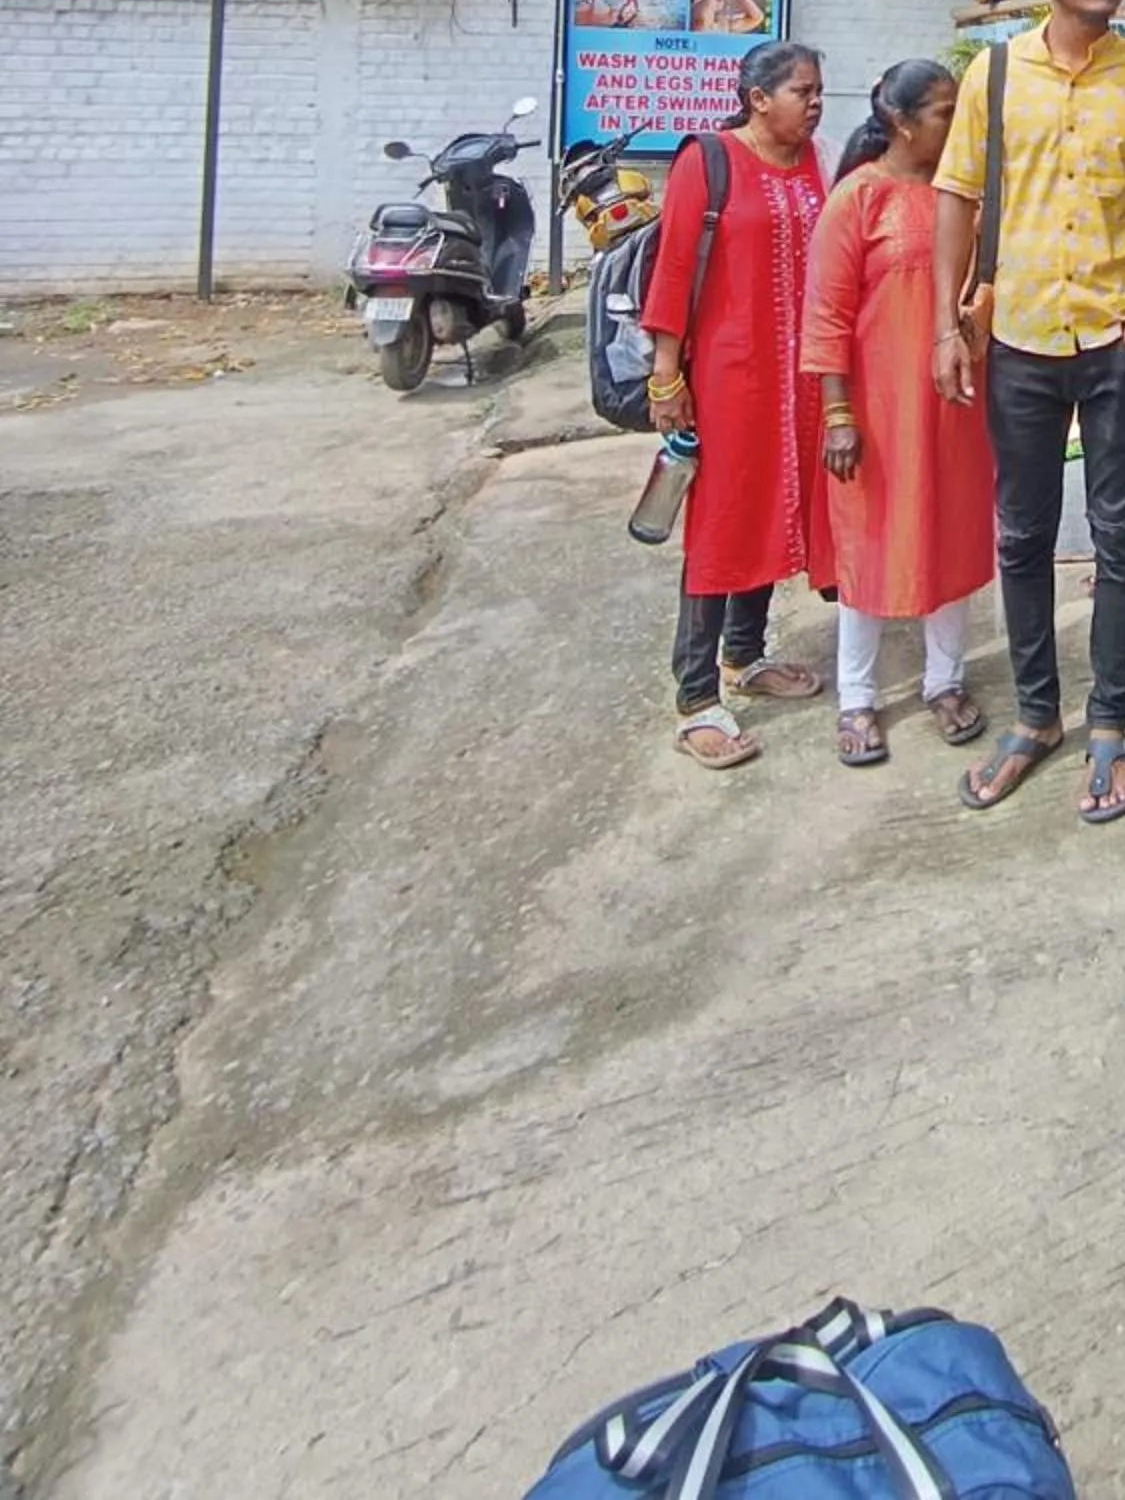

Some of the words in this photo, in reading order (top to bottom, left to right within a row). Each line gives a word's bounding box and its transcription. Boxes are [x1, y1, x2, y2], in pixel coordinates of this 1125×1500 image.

[579, 52, 637, 70] WASH
[644, 54, 697, 71] YOUR
[703, 56, 743, 73] HAN
[596, 74, 637, 90] AND
[644, 75, 693, 92] LEGS
[701, 77, 738, 92] HER
[586, 94, 650, 111] AFTER
[656, 96, 739, 113] SWIMMIN
[600, 115, 622, 129] IN
[628, 115, 667, 131] THE
[673, 116, 723, 132] BEAC
